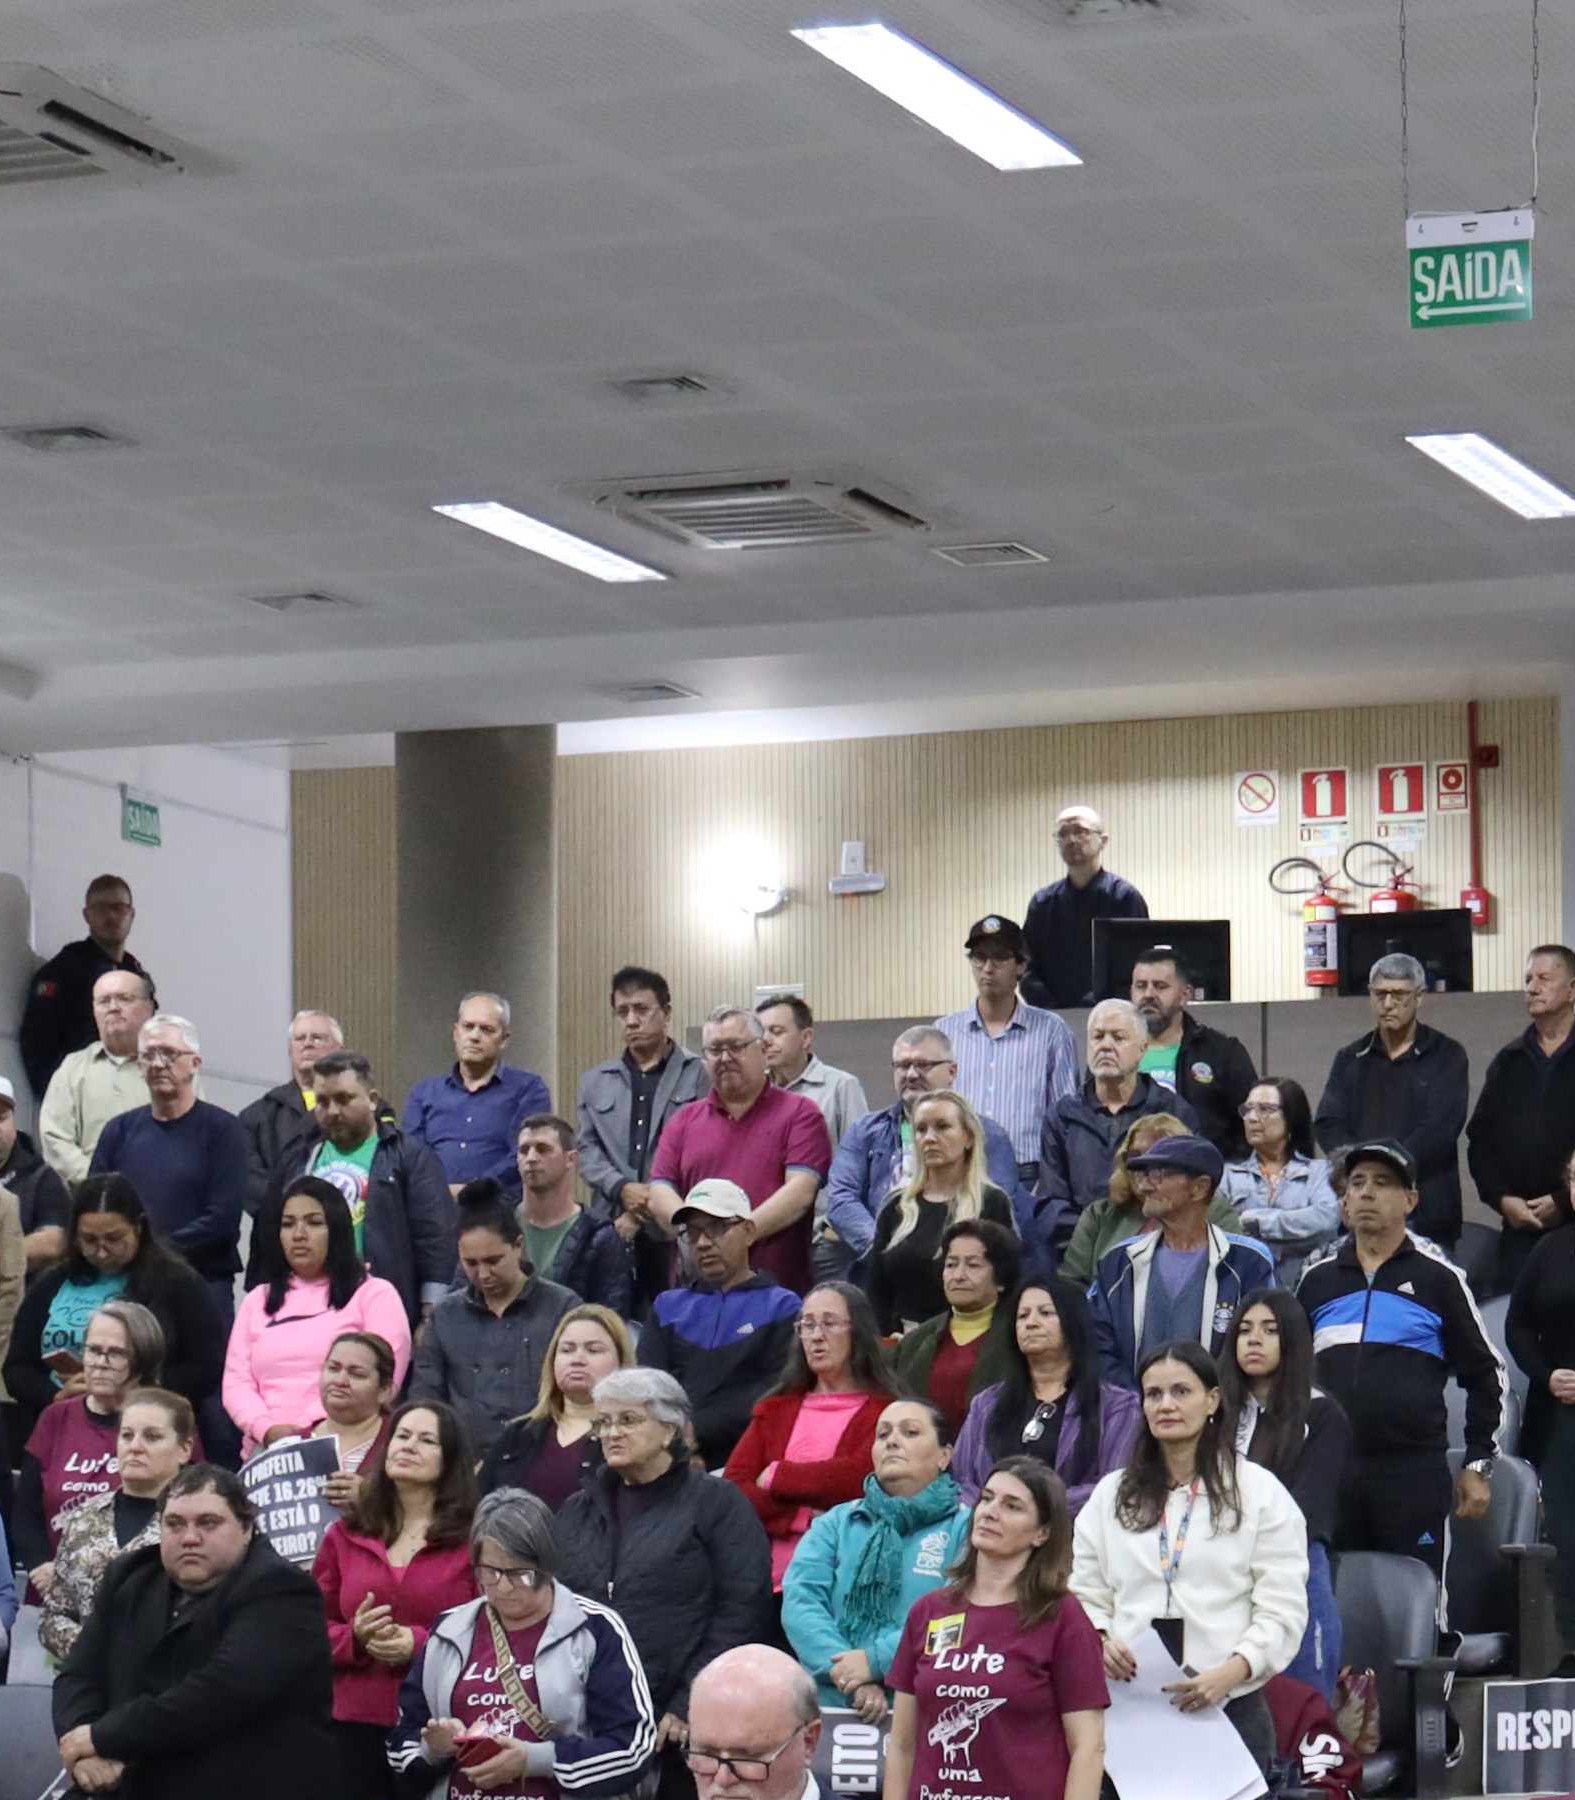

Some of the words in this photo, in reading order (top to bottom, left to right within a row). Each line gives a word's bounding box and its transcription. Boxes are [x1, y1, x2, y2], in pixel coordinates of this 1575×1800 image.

[62, 1481, 110, 1492] como
[308, 1503, 321, 1524] O
[934, 1643, 1006, 1674] Lute
[935, 1684, 991, 1699] como
[938, 1767, 983, 1783] uma
